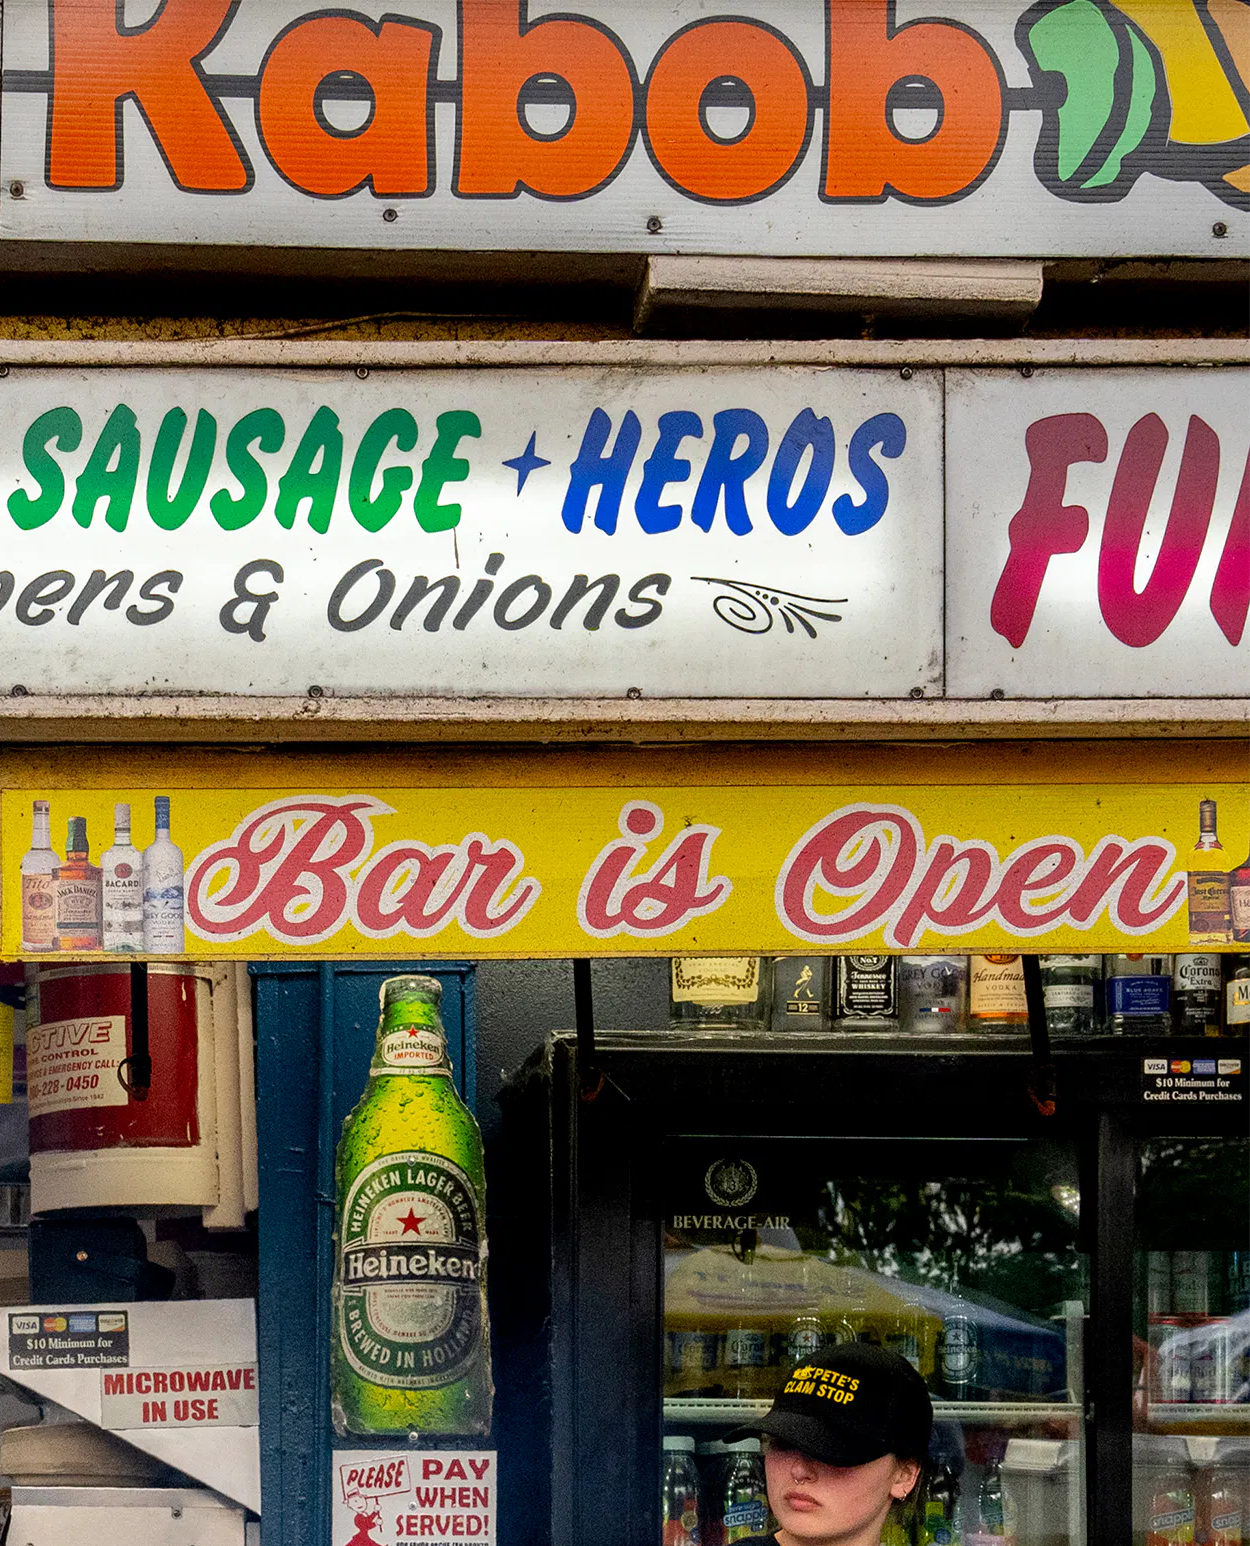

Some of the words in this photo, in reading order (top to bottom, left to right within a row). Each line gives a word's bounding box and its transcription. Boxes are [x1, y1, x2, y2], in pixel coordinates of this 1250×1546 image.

[44, 0, 1009, 206] Kabob
[6, 404, 482, 536] SAUSAGE
[561, 406, 908, 536] HEROS
[990, 412, 1250, 649] FU
[219, 559, 284, 642] &
[325, 552, 672, 633] Onions
[187, 800, 535, 940] Bar
[585, 806, 725, 931] is
[783, 809, 1186, 947] Open
[1189, 978, 1212, 986] Extra
[797, 1003, 809, 1013] 12
[41, 1048, 99, 1063] CONTROL
[386, 1040, 440, 1055] Heineken
[394, 1051, 434, 1061] IMPORTED
[49, 1061, 95, 1076] EMERGENCY
[95, 1059, 120, 1070] CALL:
[1147, 1063, 1166, 1071] VISA
[1156, 1078, 1173, 1088] $10
[1175, 1078, 1215, 1088] Minimum
[1216, 1078, 1230, 1088] for
[1144, 1091, 1170, 1101] Credit
[1171, 1091, 1197, 1101] Cards
[1199, 1091, 1242, 1101] Purchases
[351, 1170, 401, 1233] HEINEKEN
[407, 1169, 455, 1197] LAGER
[673, 1215, 790, 1230] BEVERAGE-AIR
[348, 1250, 476, 1279] Heineken
[16, 1321, 37, 1330] VISA
[26, 1338, 46, 1349] $10
[48, 1337, 95, 1349] Minimum
[97, 1337, 113, 1348] for
[349, 1308, 391, 1365] BREWED
[396, 1351, 415, 1368] IN
[13, 1354, 44, 1366] Credit
[46, 1353, 75, 1365] Cards
[77, 1353, 128, 1365] Purchases
[104, 1369, 256, 1395] MICROWAVE
[813, 1367, 860, 1391] PETE'S
[784, 1380, 816, 1395] CLAM
[816, 1384, 854, 1405] STOP
[142, 1401, 167, 1423] IN
[173, 1399, 219, 1422] USE
[347, 1459, 405, 1489] PLEASE
[422, 1459, 490, 1480] PAY
[416, 1487, 489, 1508] WHEN
[396, 1515, 489, 1537] SERVED!
